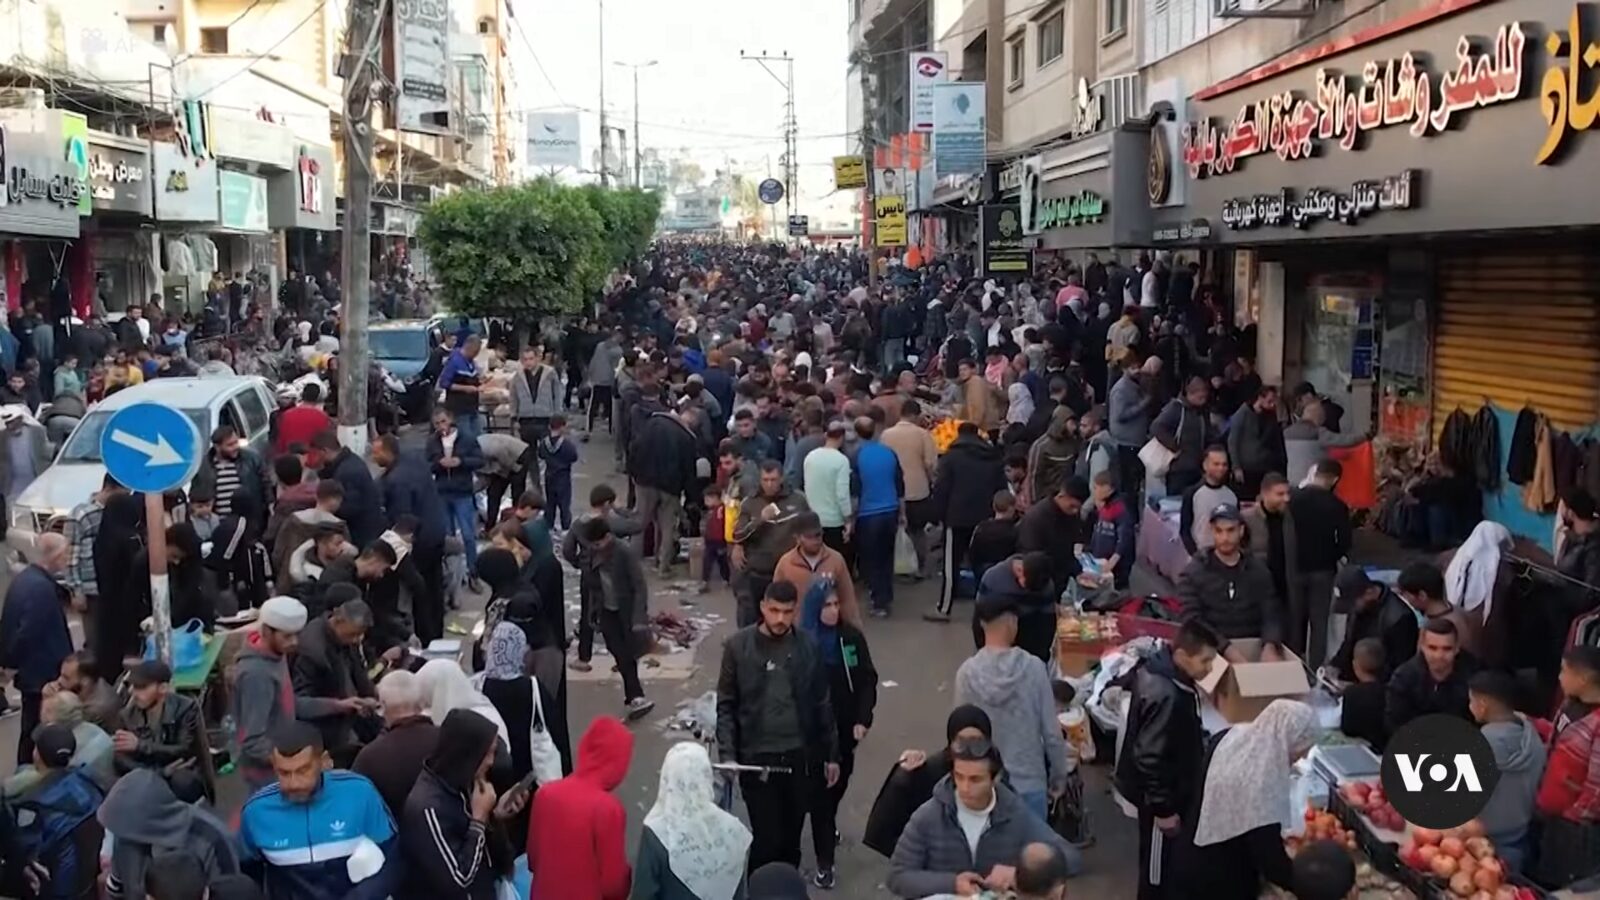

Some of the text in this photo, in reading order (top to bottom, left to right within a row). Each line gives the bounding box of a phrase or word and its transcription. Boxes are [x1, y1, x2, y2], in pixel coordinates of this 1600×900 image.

[1358, 21, 1525, 137] للمفروشات
[1222, 171, 1411, 228] أثاث منزلي ومكتبي أجهزة كهربائية
